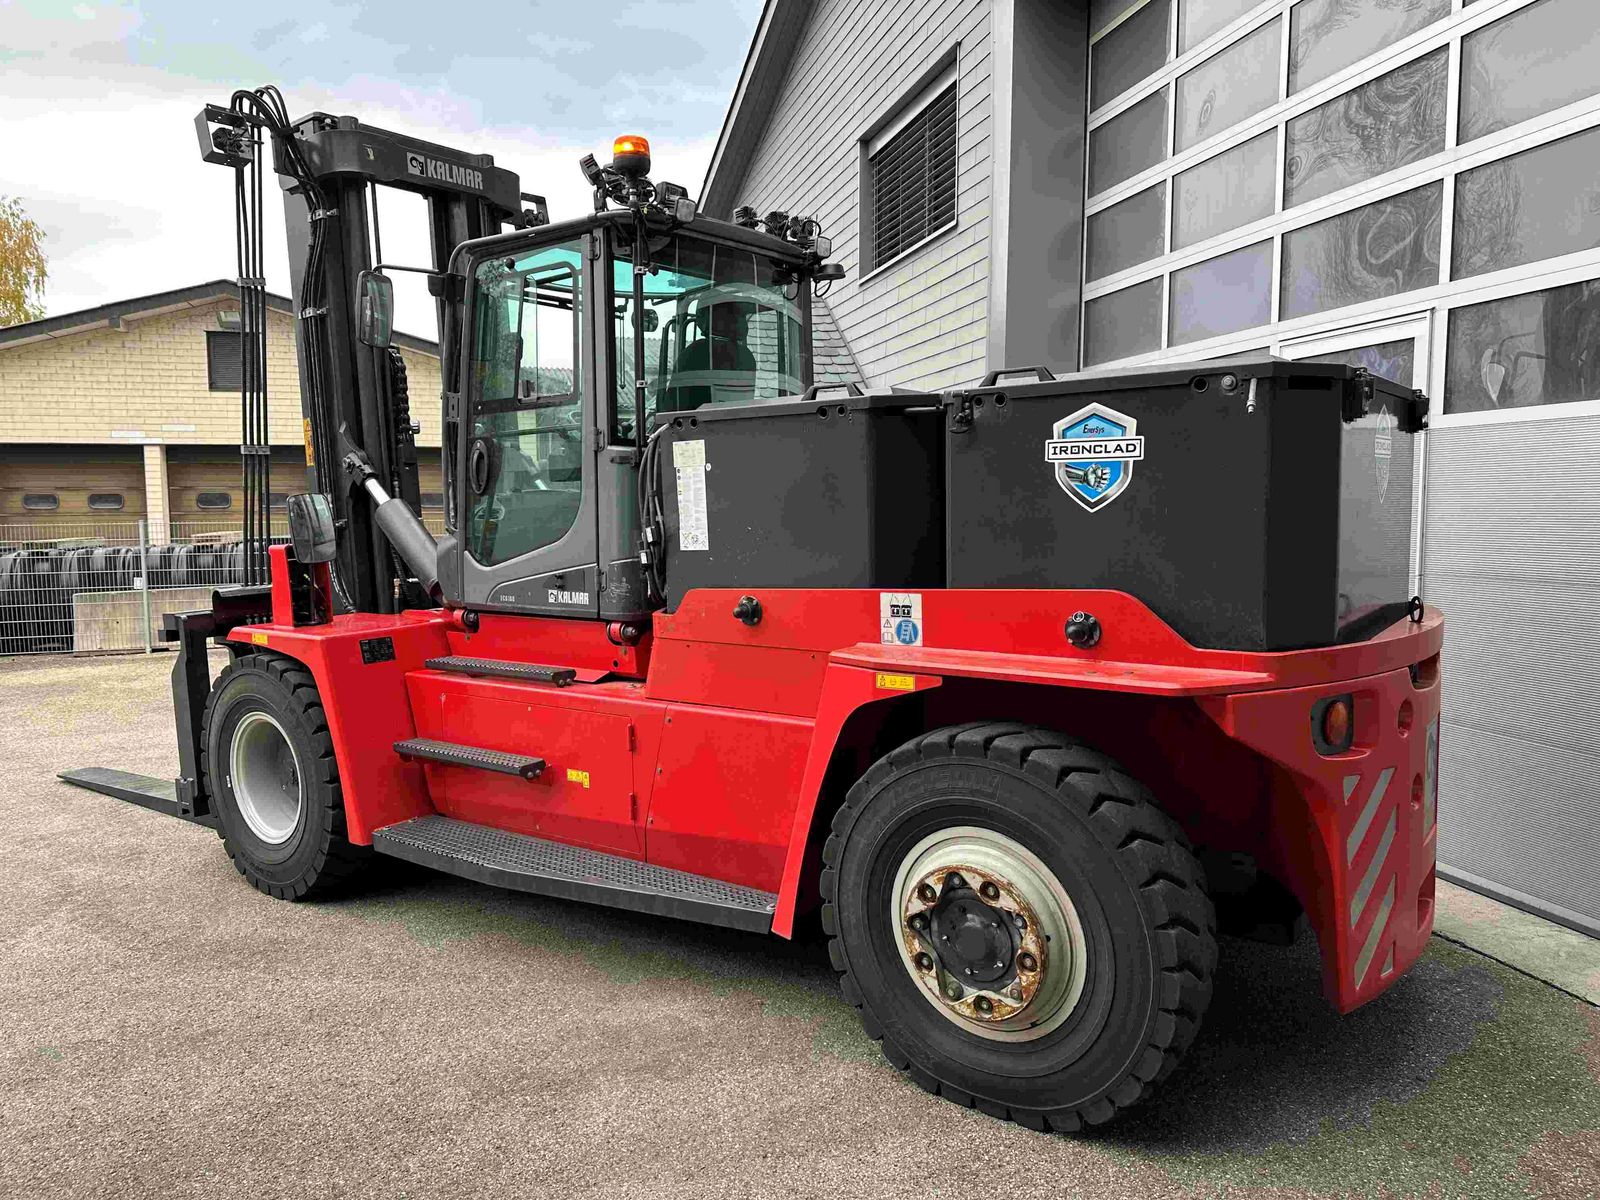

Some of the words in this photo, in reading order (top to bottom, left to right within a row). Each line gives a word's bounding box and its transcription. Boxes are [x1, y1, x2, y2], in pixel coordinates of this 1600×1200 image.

[426, 158, 483, 190] KALMAR
[1051, 443, 1137, 456] IRONCLAD
[558, 590, 590, 605] KALMAR
